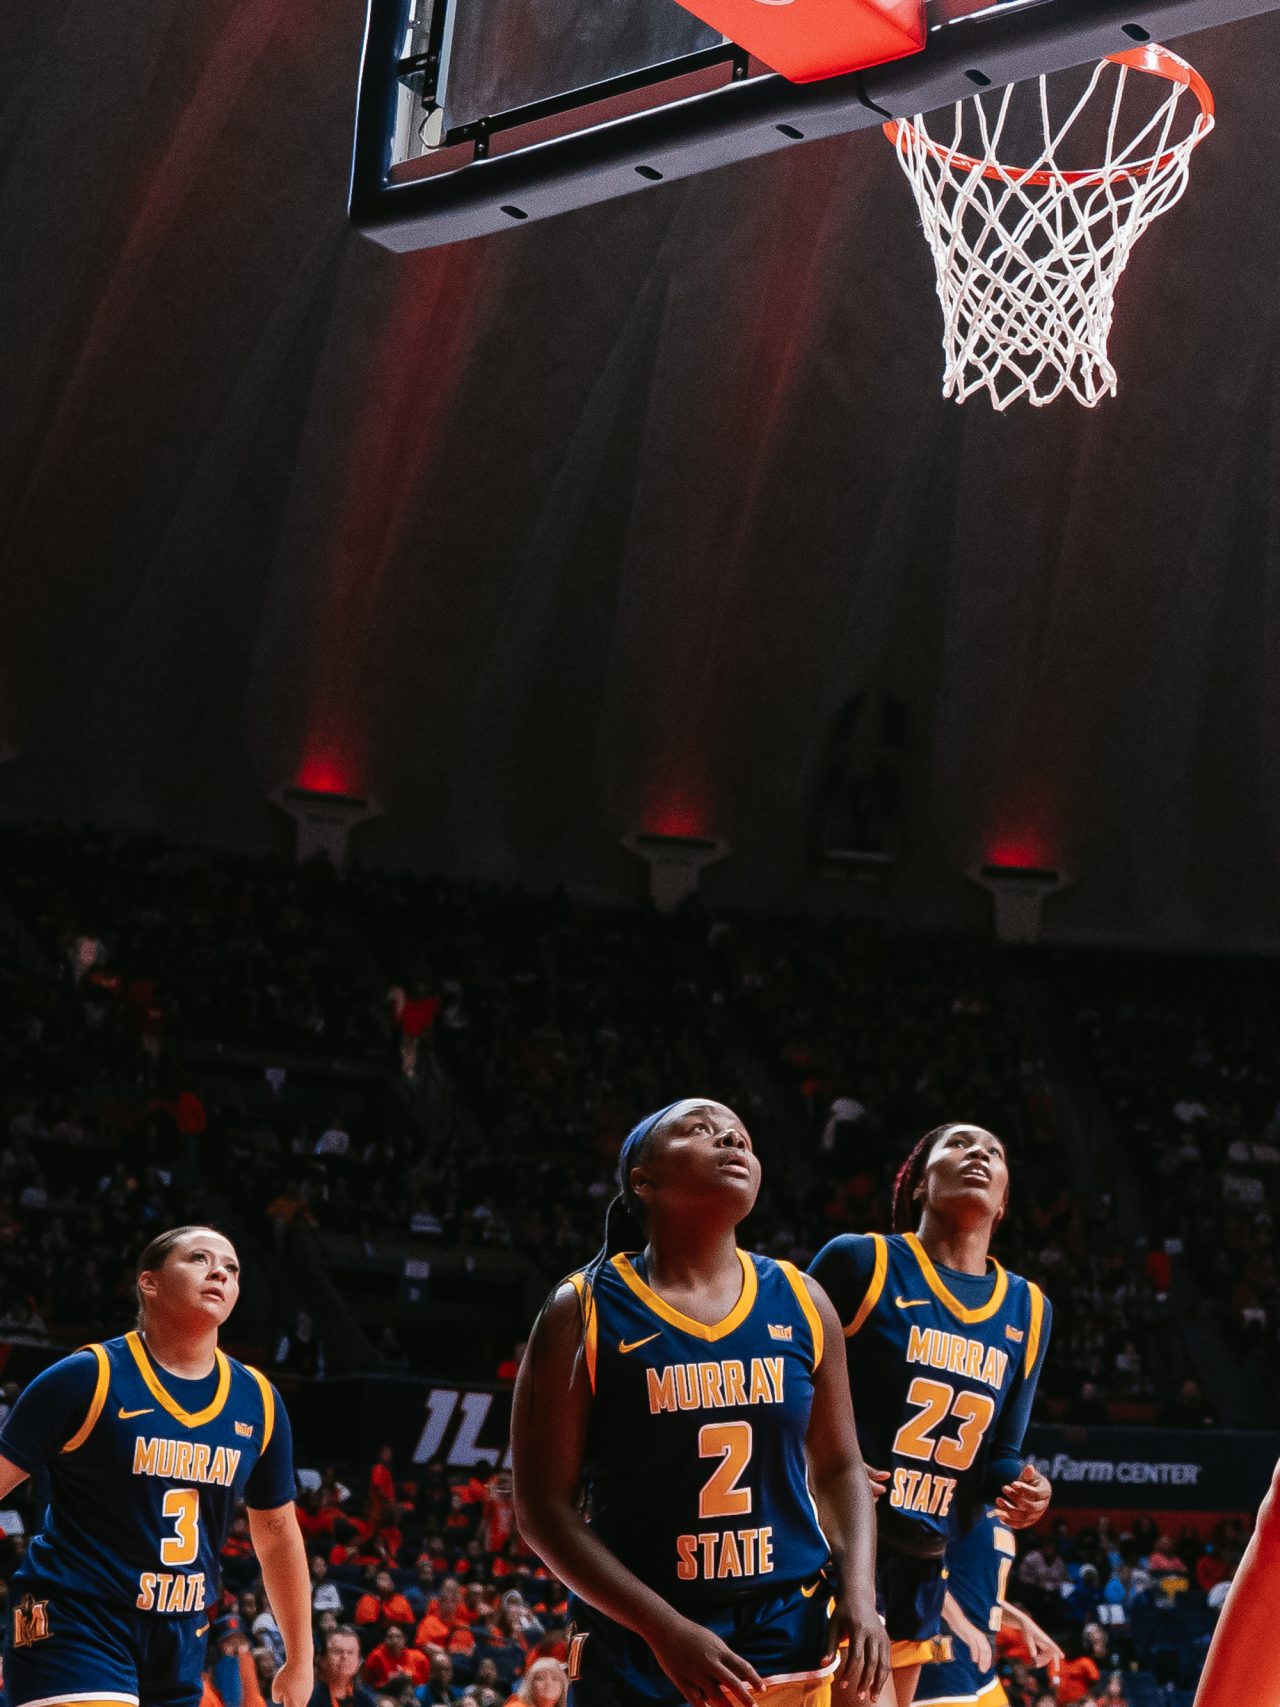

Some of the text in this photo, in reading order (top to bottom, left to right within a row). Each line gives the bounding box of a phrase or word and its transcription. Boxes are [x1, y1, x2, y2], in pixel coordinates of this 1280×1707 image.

[646, 1357, 785, 1414] MURRAY
[906, 1325, 1009, 1390] MURRAY
[891, 1377, 995, 1471] 23
[132, 1436, 241, 1487] MURRAY
[698, 1420, 752, 1518] 2
[890, 1467, 957, 1517] STATE
[160, 1488, 200, 1566] 3
[676, 1526, 774, 1580] STATE
[136, 1572, 206, 1612] STATE
